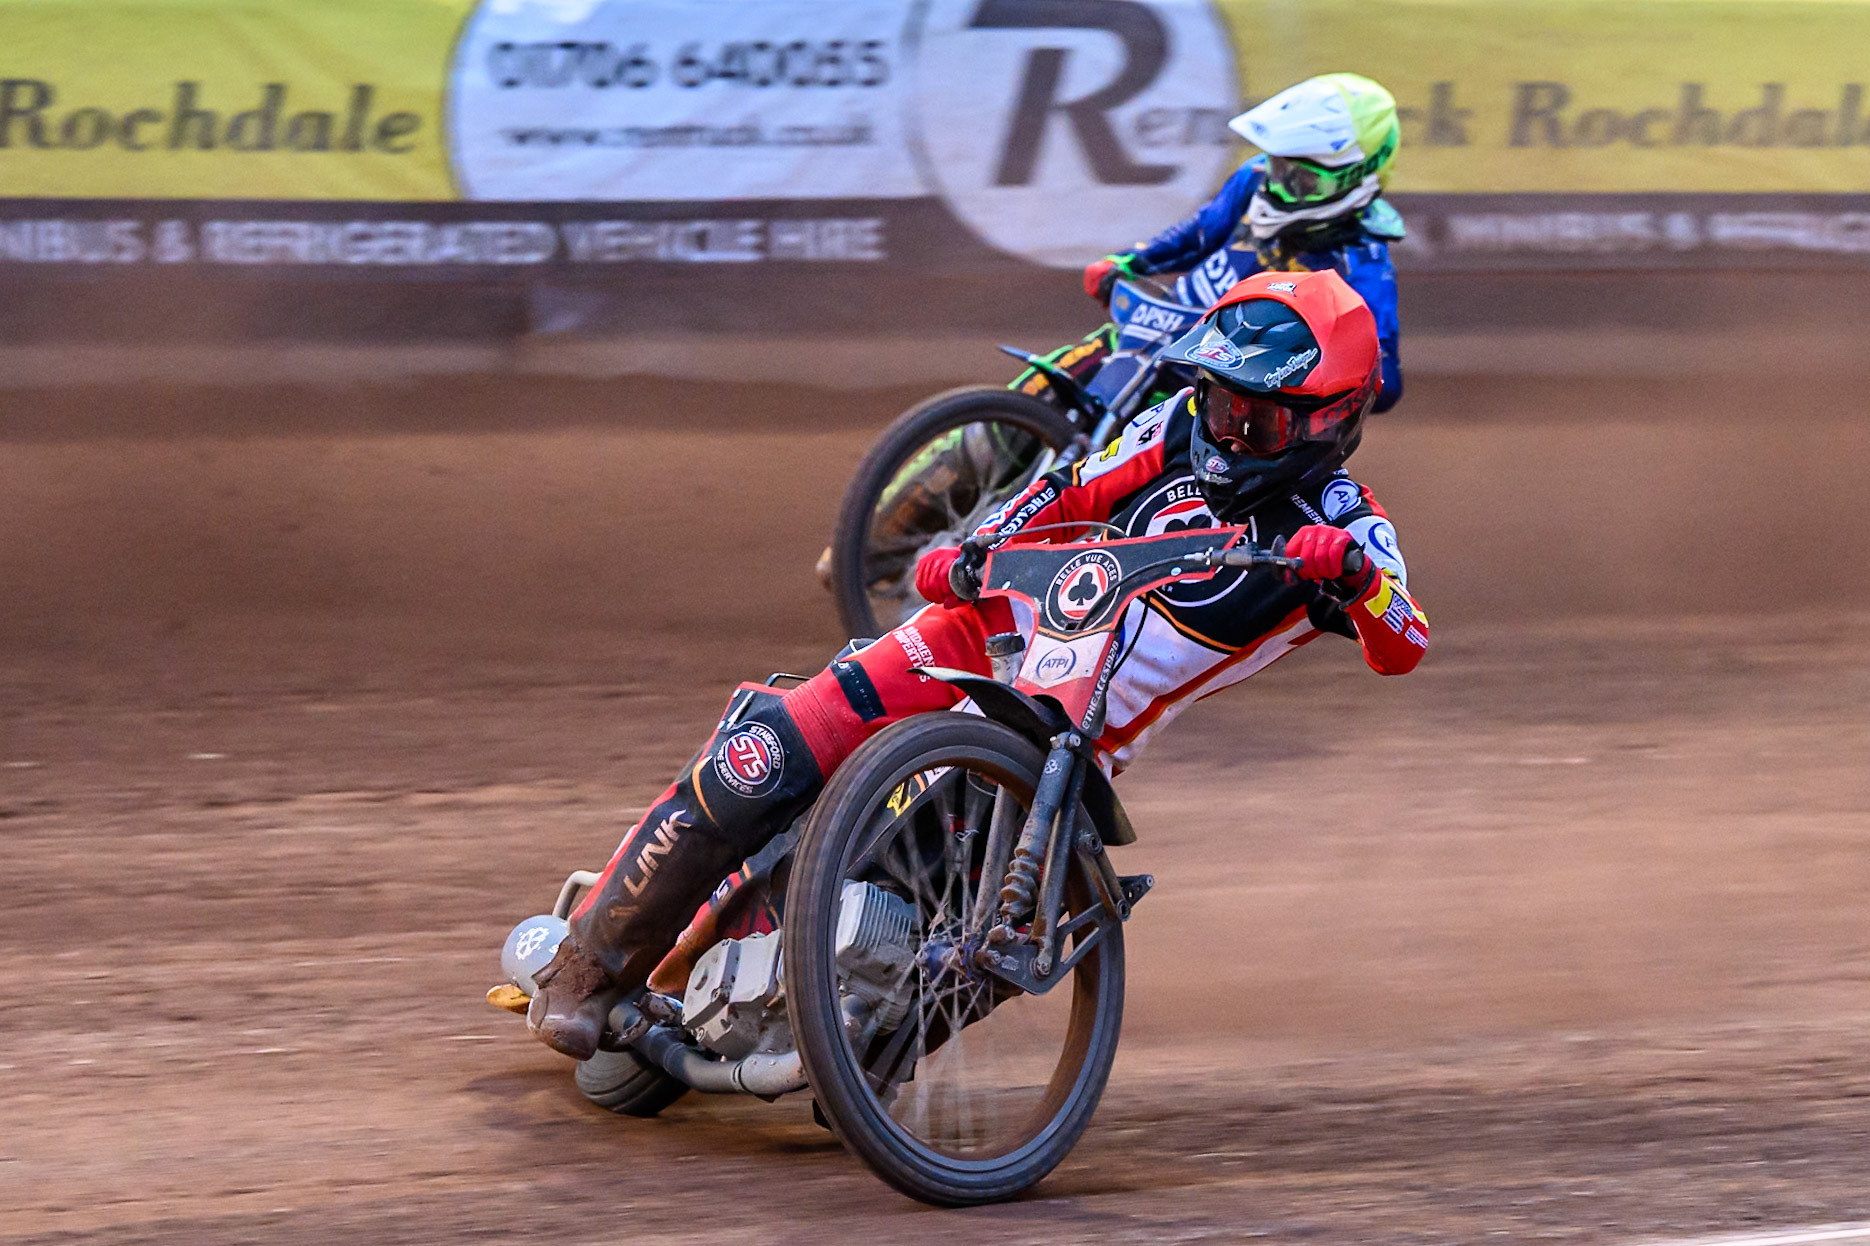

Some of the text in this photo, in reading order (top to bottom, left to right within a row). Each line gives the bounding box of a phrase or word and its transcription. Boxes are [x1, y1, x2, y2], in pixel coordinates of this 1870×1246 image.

[0, 79, 422, 153] Rochdale
[1506, 81, 1870, 148] Rochdal
[1167, 484, 1202, 502] BELL
[1055, 554, 1117, 586] BELLE VUE ACES
[892, 629, 931, 683] PROPERTIS
[1041, 657, 1069, 669] ATPI
[718, 762, 754, 794] SERVICES
[731, 735, 768, 779] STS
[623, 809, 692, 898] LINK
